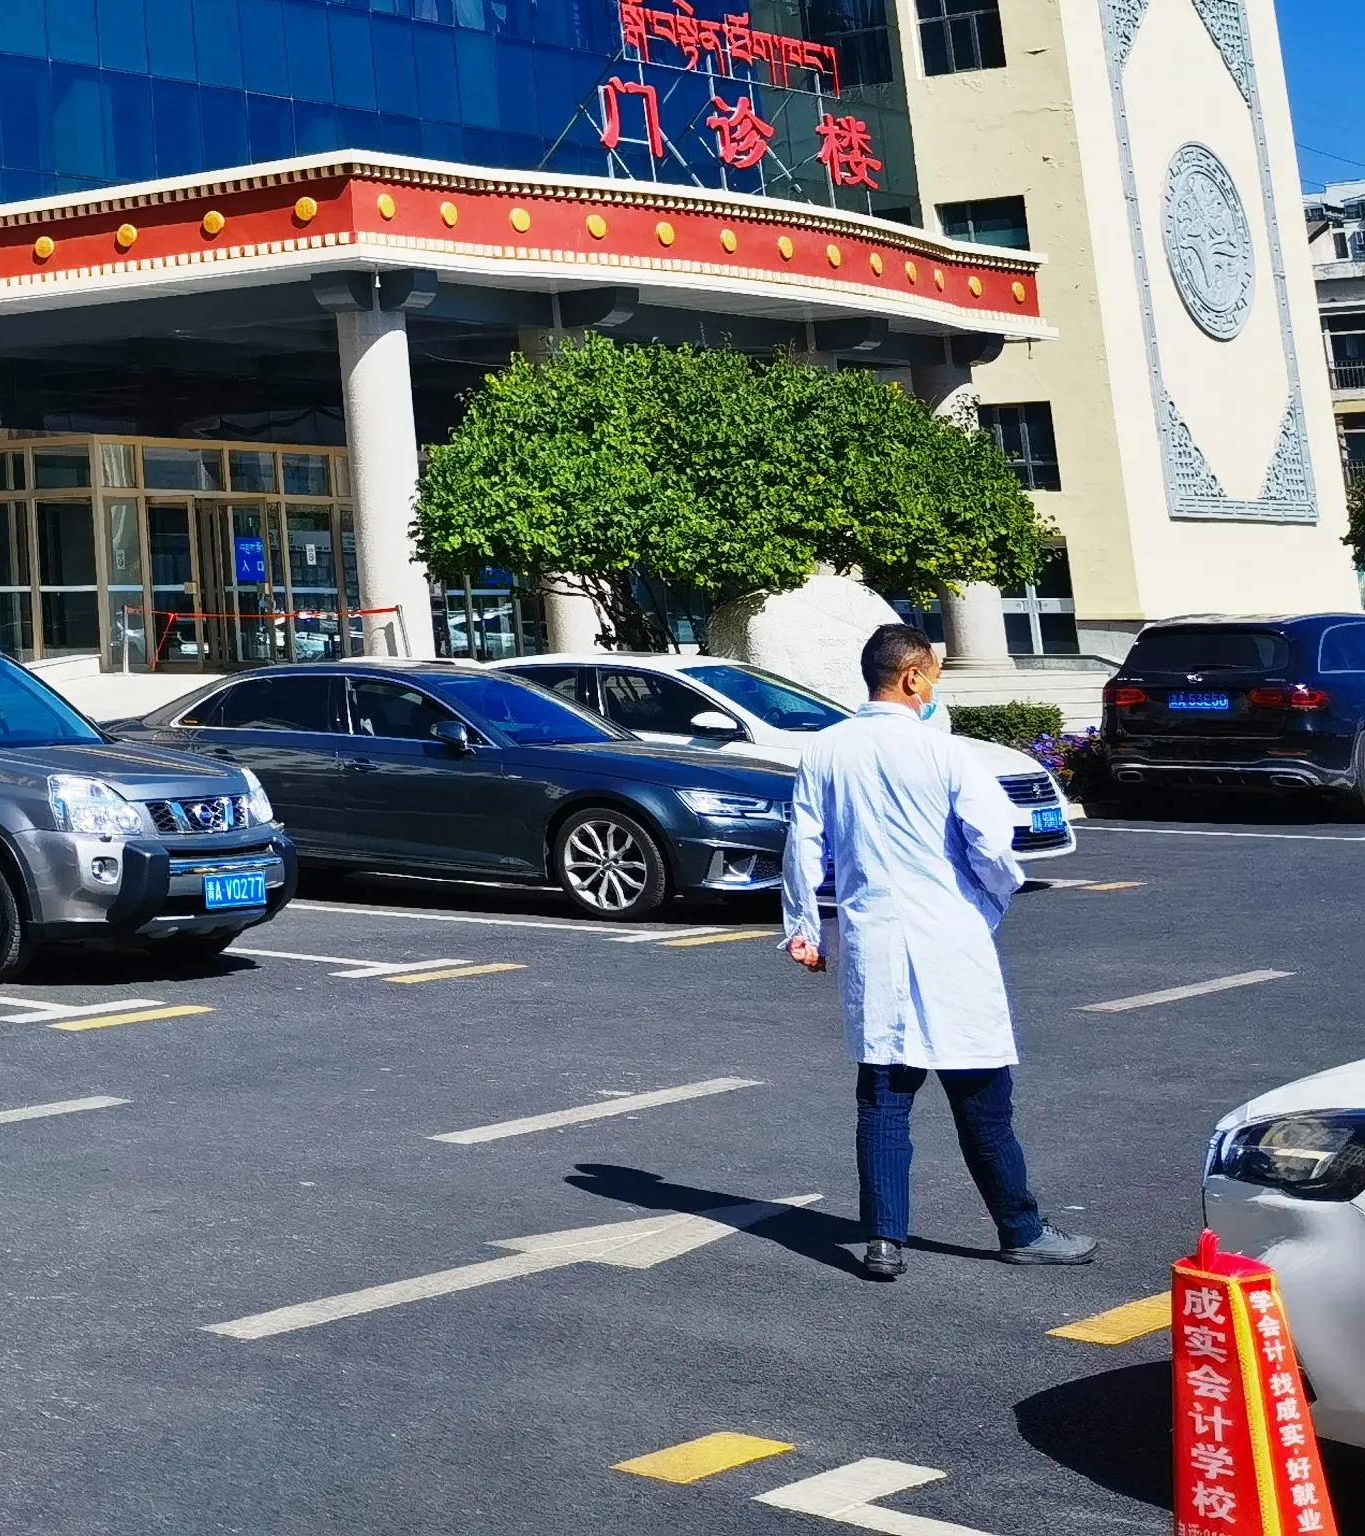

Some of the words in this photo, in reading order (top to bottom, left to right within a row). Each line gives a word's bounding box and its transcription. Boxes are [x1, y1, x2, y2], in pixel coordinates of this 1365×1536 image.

[601, 76, 884, 189] 门诊楼
[241, 559, 265, 572] 入口
[1182, 1286, 1237, 1524] 成实会计学校
